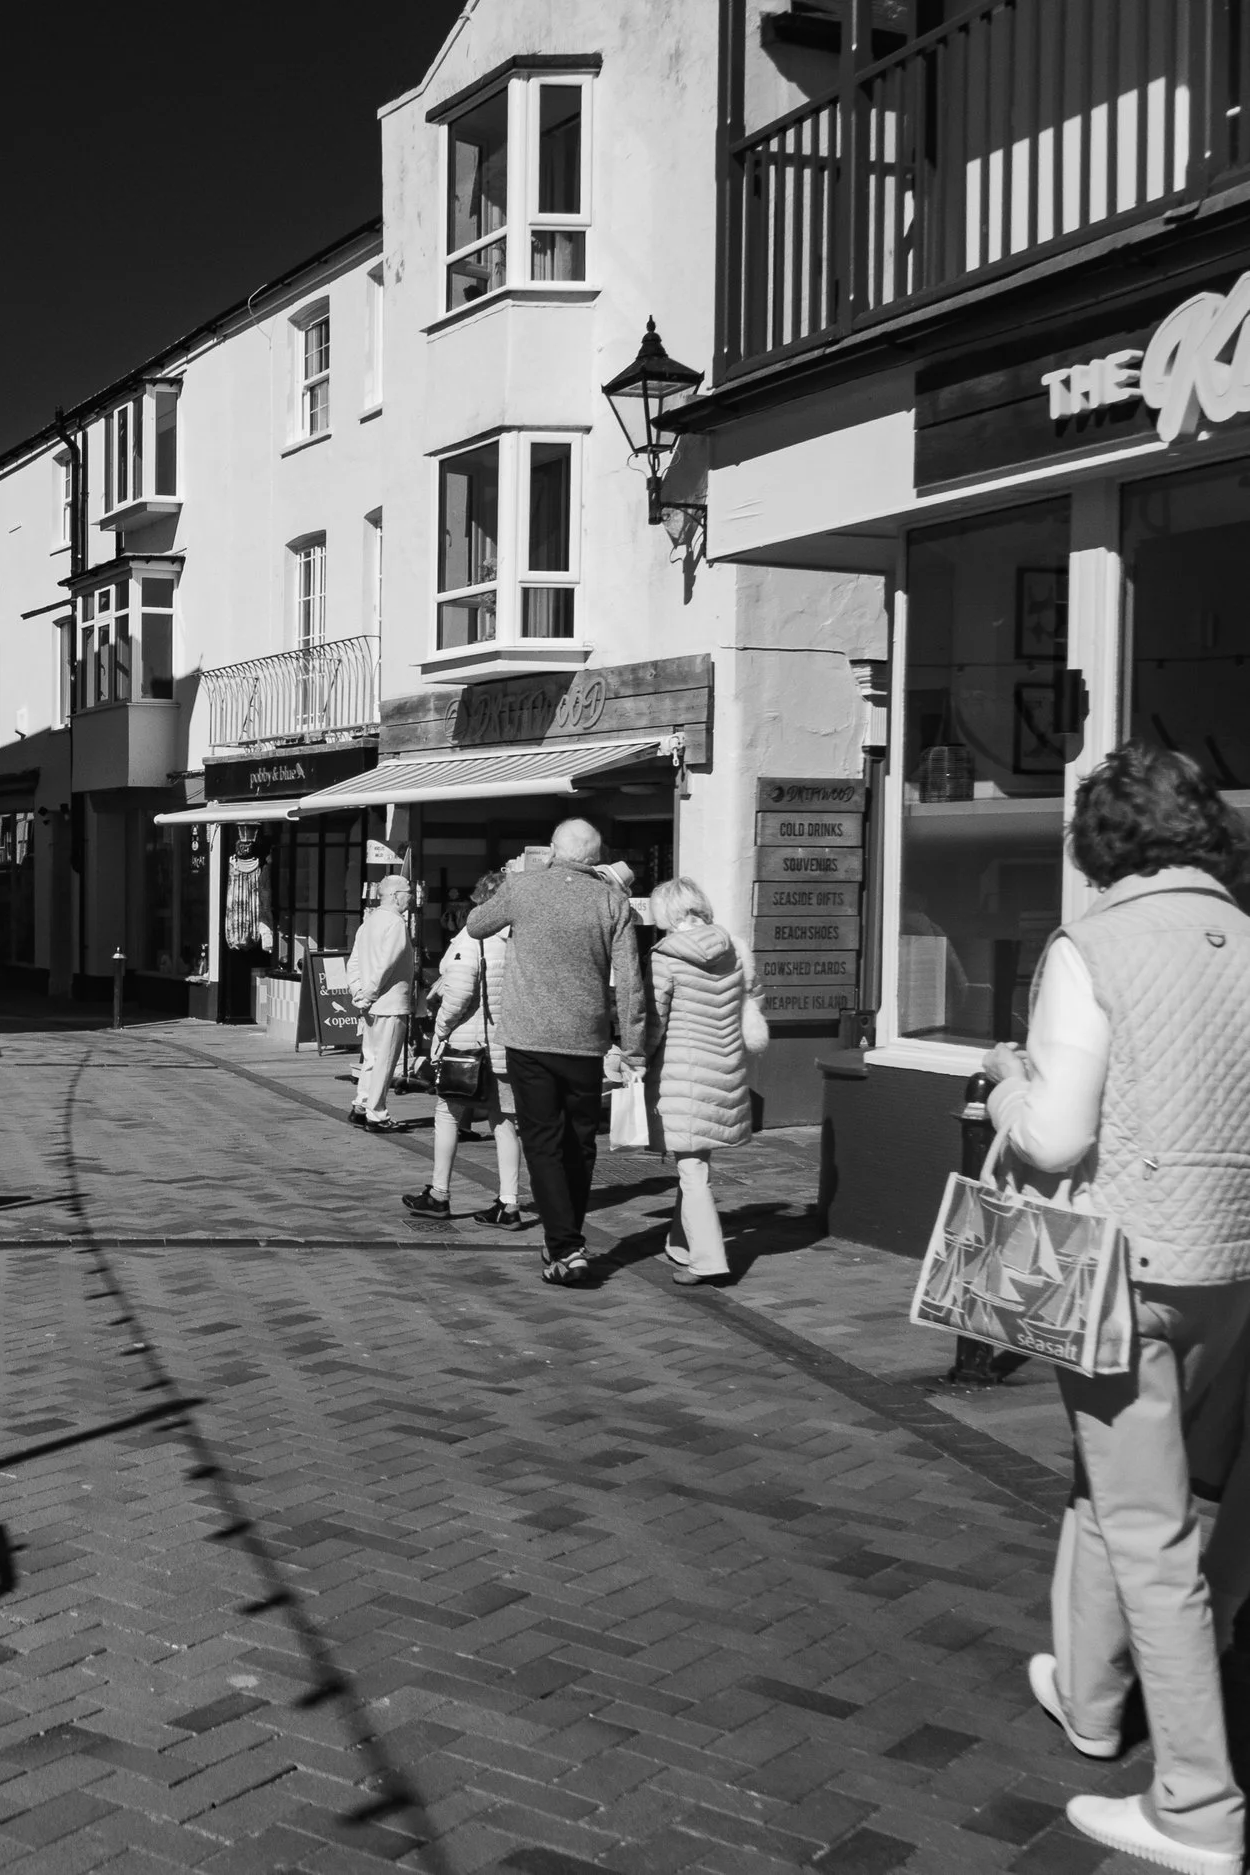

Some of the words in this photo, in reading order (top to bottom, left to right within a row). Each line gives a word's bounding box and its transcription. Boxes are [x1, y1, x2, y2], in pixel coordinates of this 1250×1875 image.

[1041, 349, 1145, 420] THE
[279, 765, 296, 781] blue
[786, 785, 855, 803] DRIFTWOOD
[779, 822, 805, 837] COLD
[807, 822, 844, 837] DRINKS
[782, 857, 838, 872] SOUVENIRS
[772, 891, 813, 906] SEASIDE
[816, 892, 845, 906] GIFTS
[763, 961, 810, 976] COWSHED
[813, 961, 847, 975] CARDS
[812, 995, 848, 1010] ISLAND
[332, 1015, 358, 1028] open
[1016, 1333, 1078, 1361] seasalt
